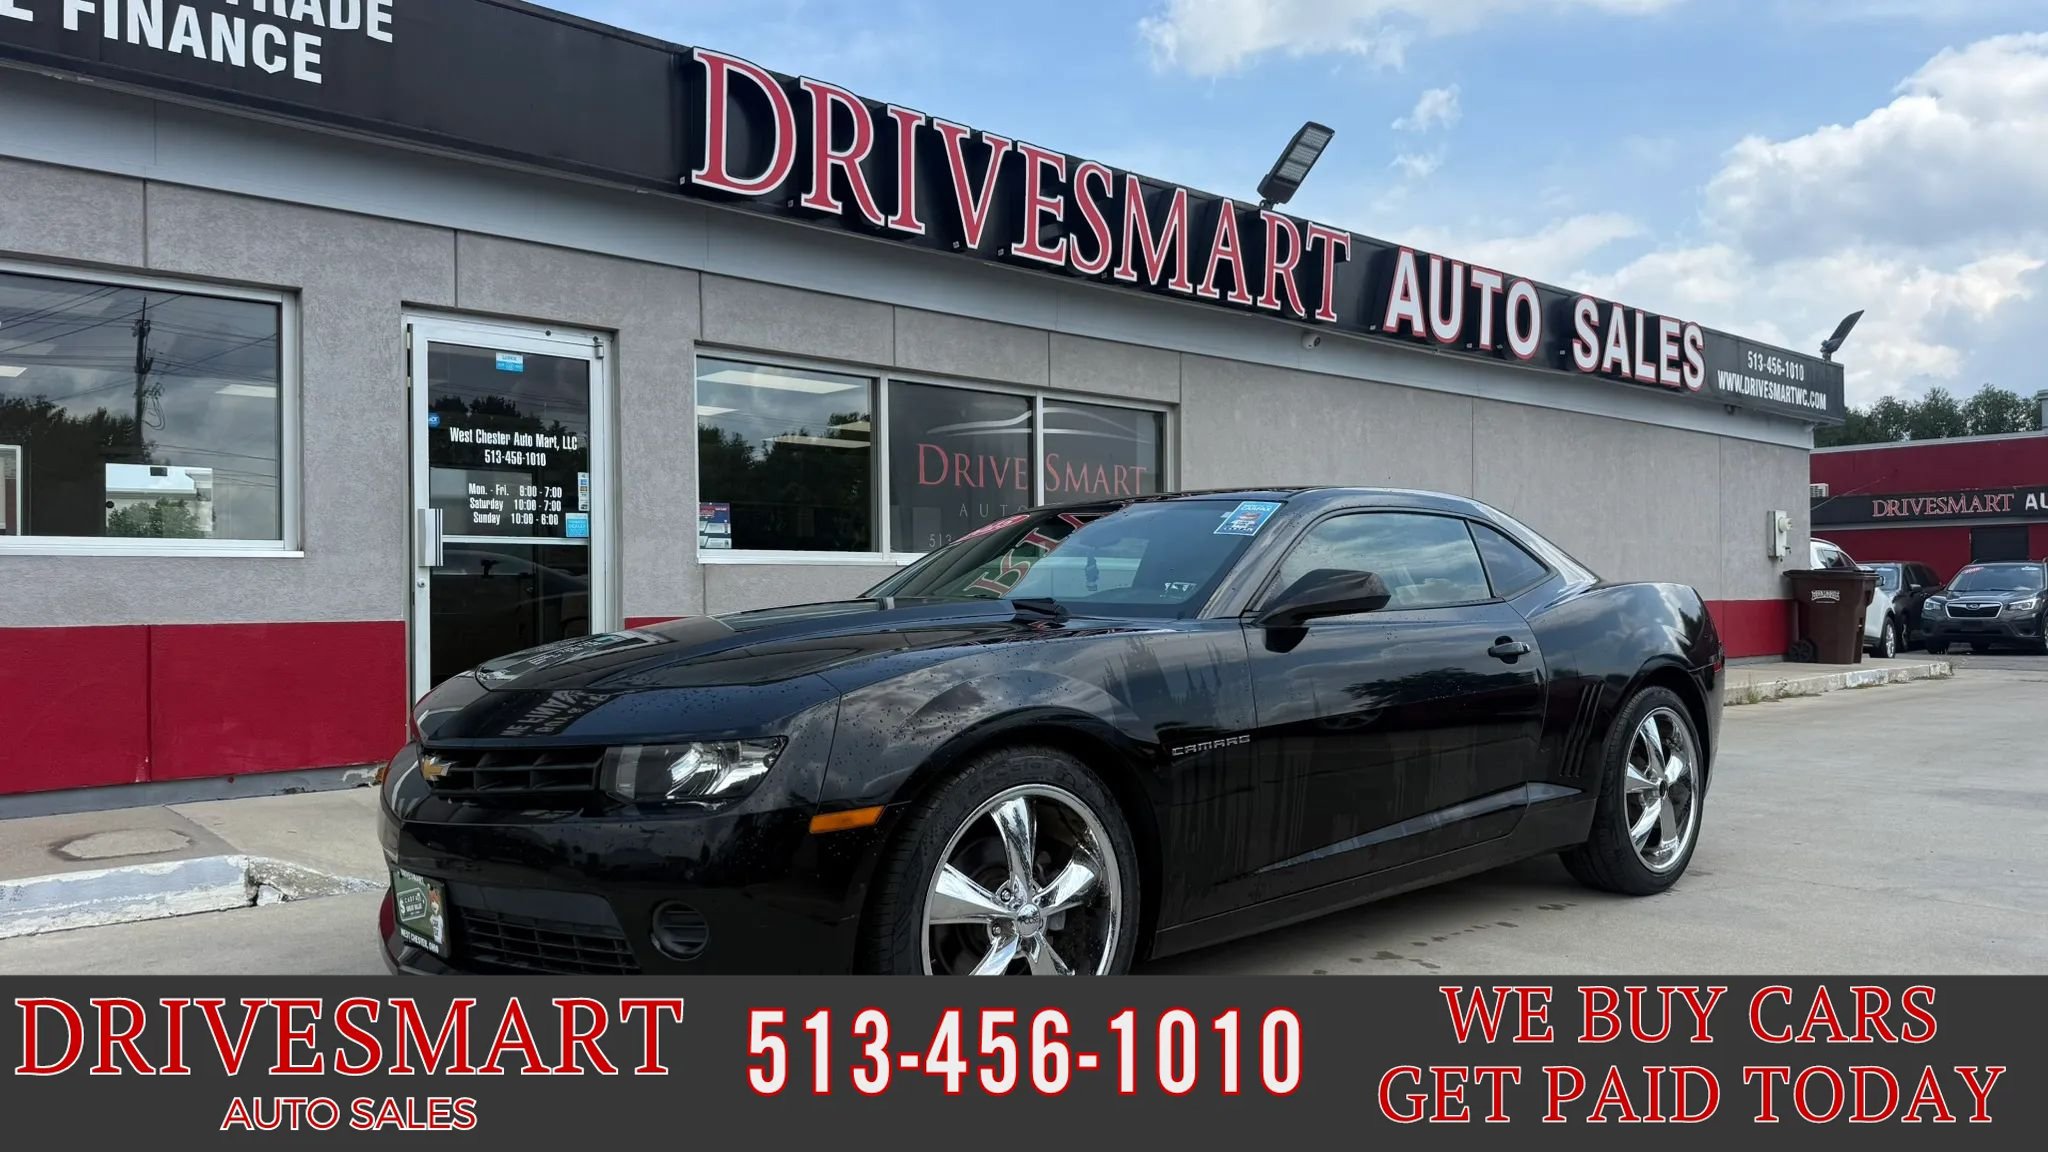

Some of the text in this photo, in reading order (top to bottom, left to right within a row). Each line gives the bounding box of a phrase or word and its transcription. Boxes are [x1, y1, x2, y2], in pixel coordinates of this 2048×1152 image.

[691, 46, 1706, 392] DRIVESMART AUTO SALES
[1747, 350, 1804, 381] 513-456-1010
[1717, 370, 1827, 410] WWW.DRIVESMARTWC.COM
[450, 427, 578, 451] West Chester Auto Mart, LLC
[485, 449, 547, 467] 513-456-1010
[468, 482, 488, 495] Mon.
[495, 483, 509, 496] Fri.
[544, 486, 563, 498] 7:00
[469, 497, 504, 512] Saturday
[514, 498, 537, 511] 10:00
[543, 499, 562, 512] 7:00
[1872, 493, 2014, 517] DRIVESMART
[473, 511, 501, 526] Sunday
[511, 513, 534, 525] 10:00
[1172, 735, 1250, 756] CAMARO
